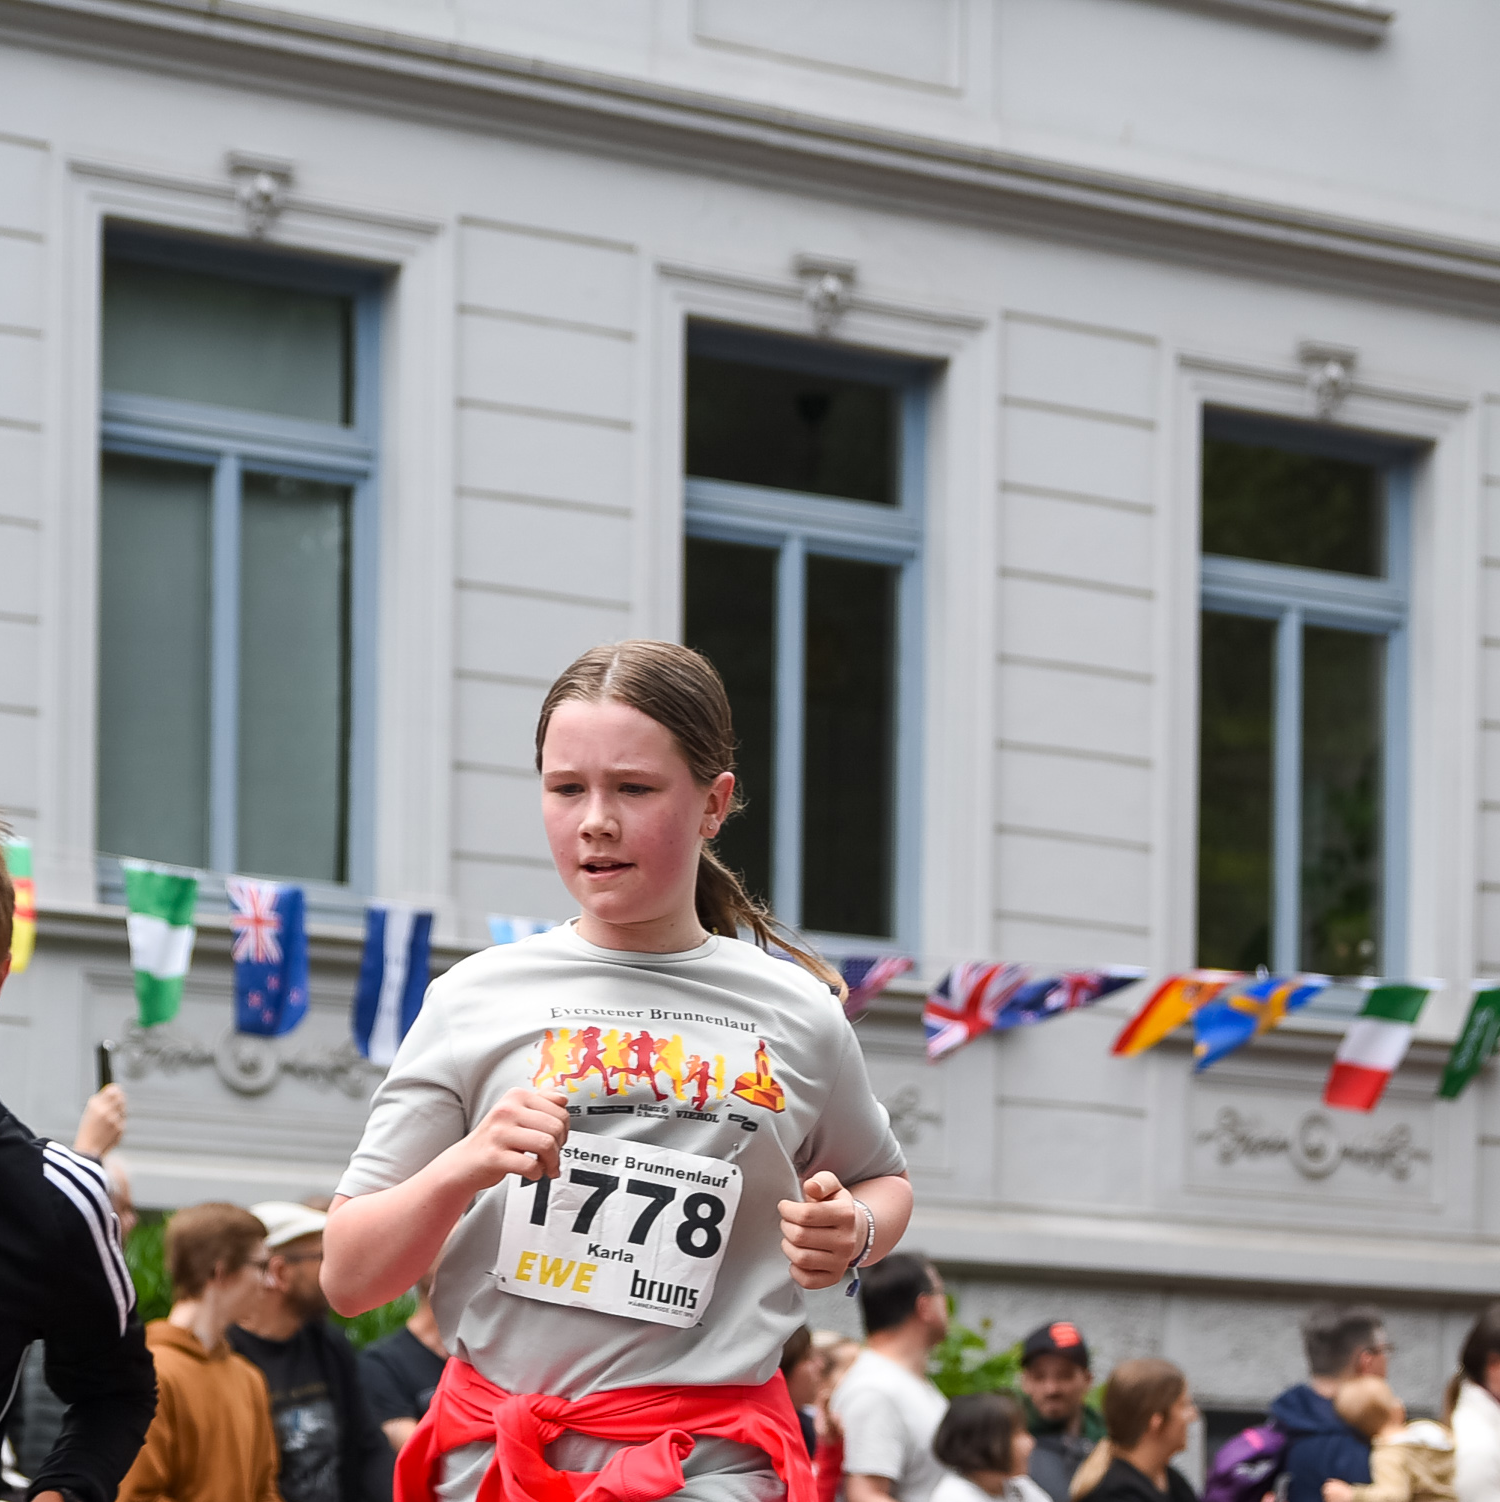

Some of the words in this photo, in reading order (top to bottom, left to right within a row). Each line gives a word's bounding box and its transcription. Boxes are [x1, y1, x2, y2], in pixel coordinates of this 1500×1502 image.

[550, 1006, 644, 1020] Everstener
[649, 1008, 758, 1034] Brunnenlauf
[675, 1110, 720, 1124] VIEROL
[560, 1147, 619, 1166] stener
[624, 1156, 729, 1189] Brunnenlauf
[520, 1168, 726, 1259] 1778
[515, 1251, 599, 1294] EWE
[586, 1243, 634, 1263] Karla
[629, 1269, 700, 1310] bruns
